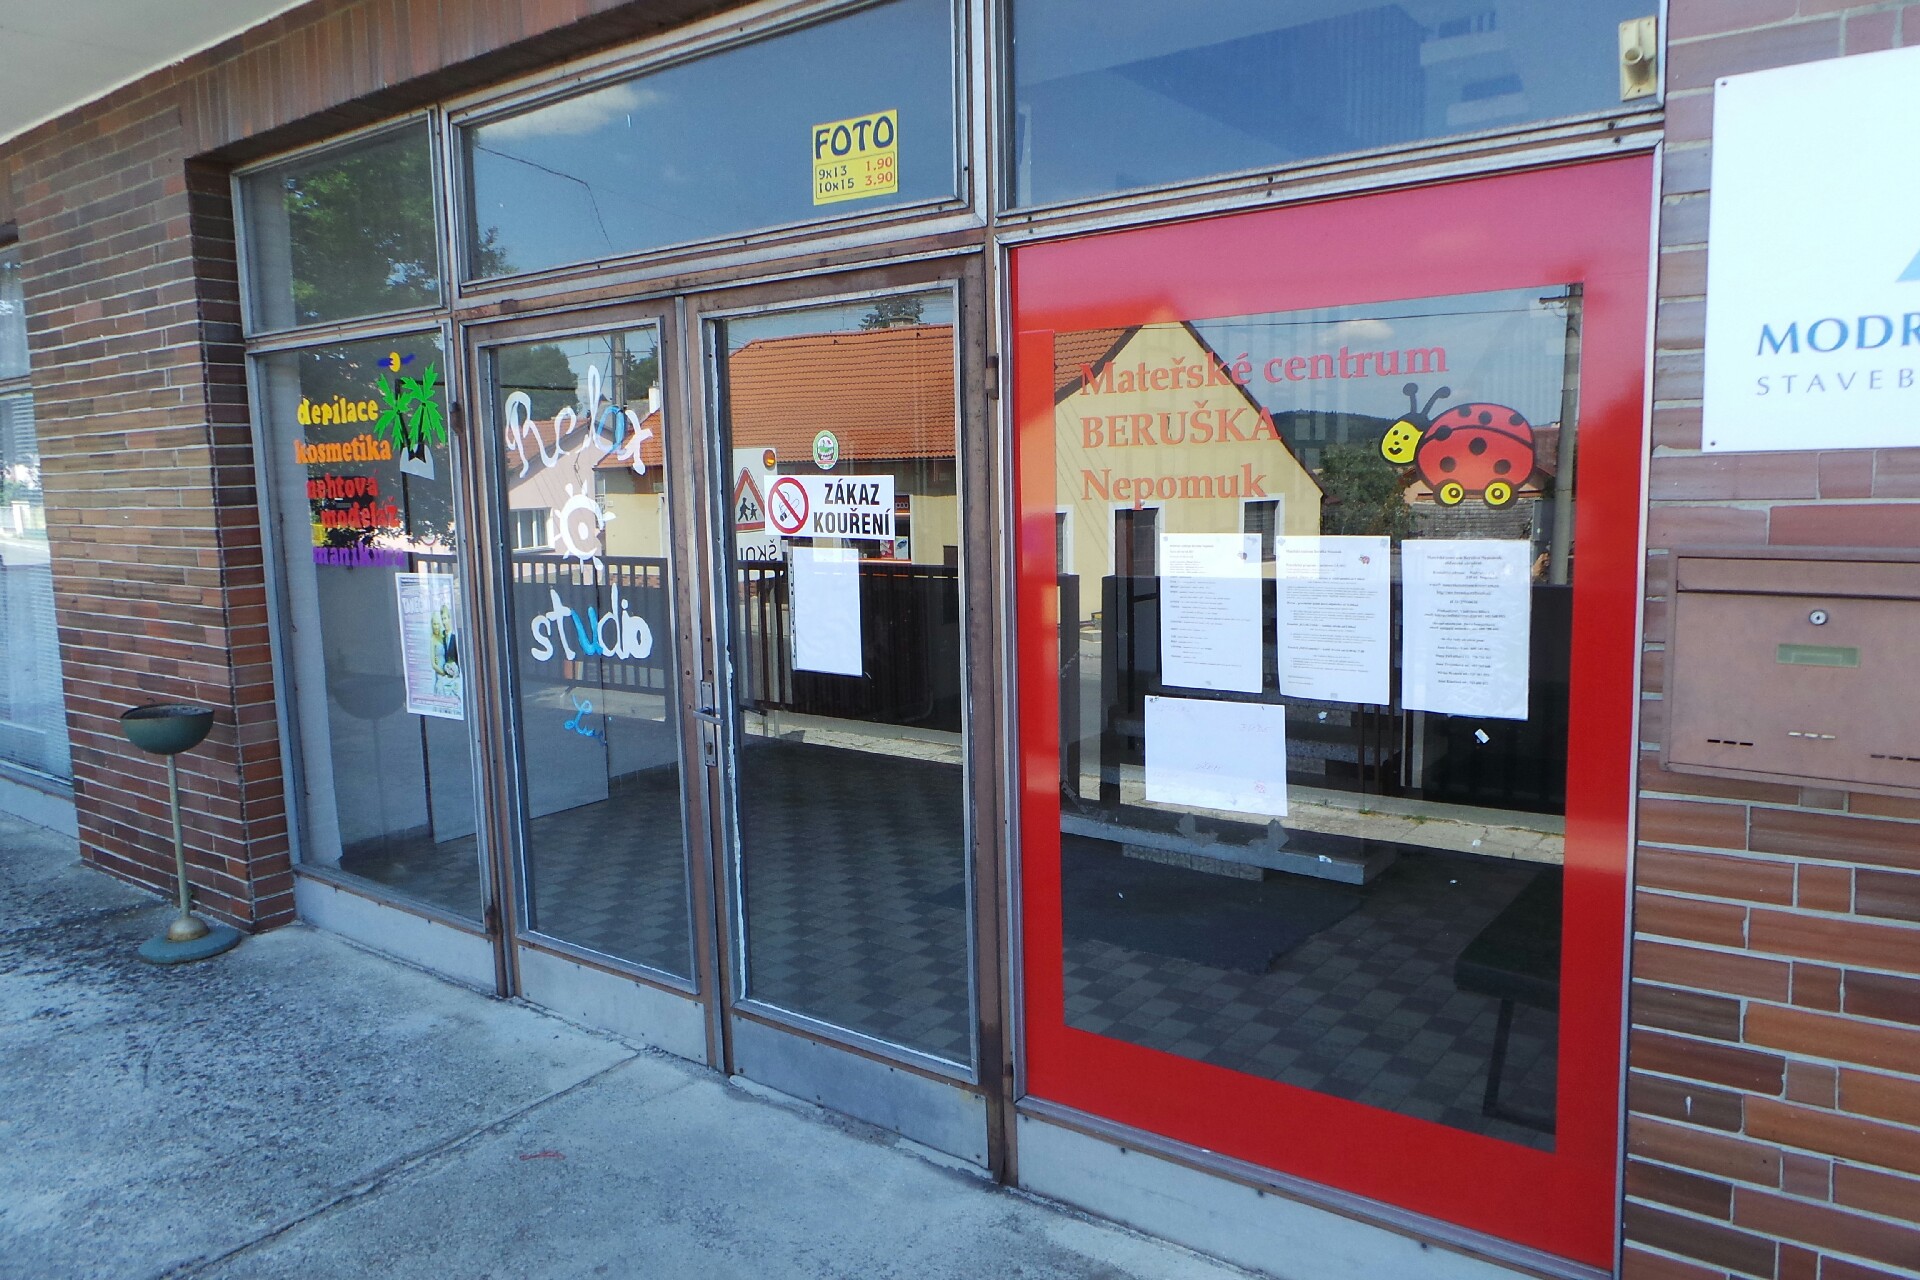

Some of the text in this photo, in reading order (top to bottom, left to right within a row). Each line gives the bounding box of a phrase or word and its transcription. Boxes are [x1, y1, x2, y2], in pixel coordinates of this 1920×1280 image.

[815, 115, 894, 160] FOTO
[818, 164, 847, 180] 9x13
[819, 177, 855, 193] 10x15
[1080, 346, 1449, 395] Mateřské centrum
[1756, 368, 1914, 396] STAVEB
[297, 394, 379, 426] depilace
[1080, 400, 1282, 449] BERUŠKA
[294, 433, 392, 464] kosmetika
[824, 478, 880, 506] ZÁKAZ
[1080, 463, 1268, 511] Nepomuk
[813, 507, 891, 536] KOUŘENÍ
[531, 582, 653, 662] studio
